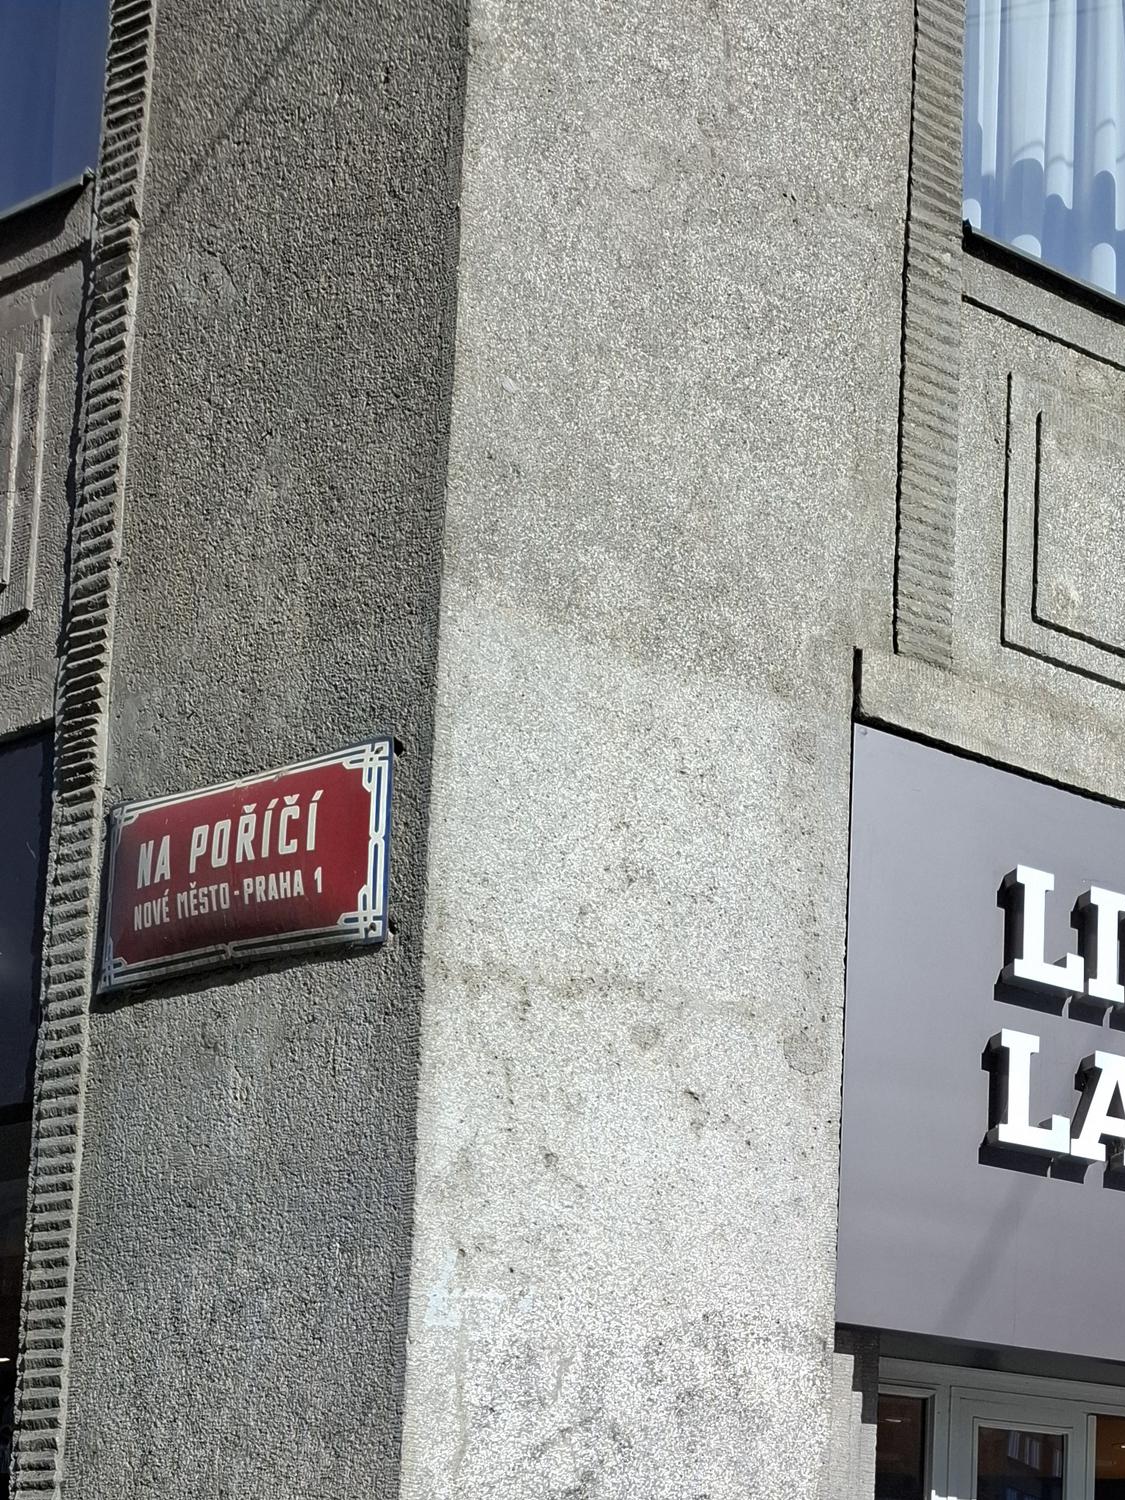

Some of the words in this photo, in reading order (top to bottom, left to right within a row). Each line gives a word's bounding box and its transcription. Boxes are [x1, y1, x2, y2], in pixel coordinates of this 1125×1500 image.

[136, 834, 171, 889] NA
[188, 789, 324, 874] POŘÍČÍ
[133, 889, 170, 931] NOVÉ
[176, 882, 231, 920] MĚSTO
[243, 869, 305, 905] PRAHA
[313, 866, 323, 894] 1
